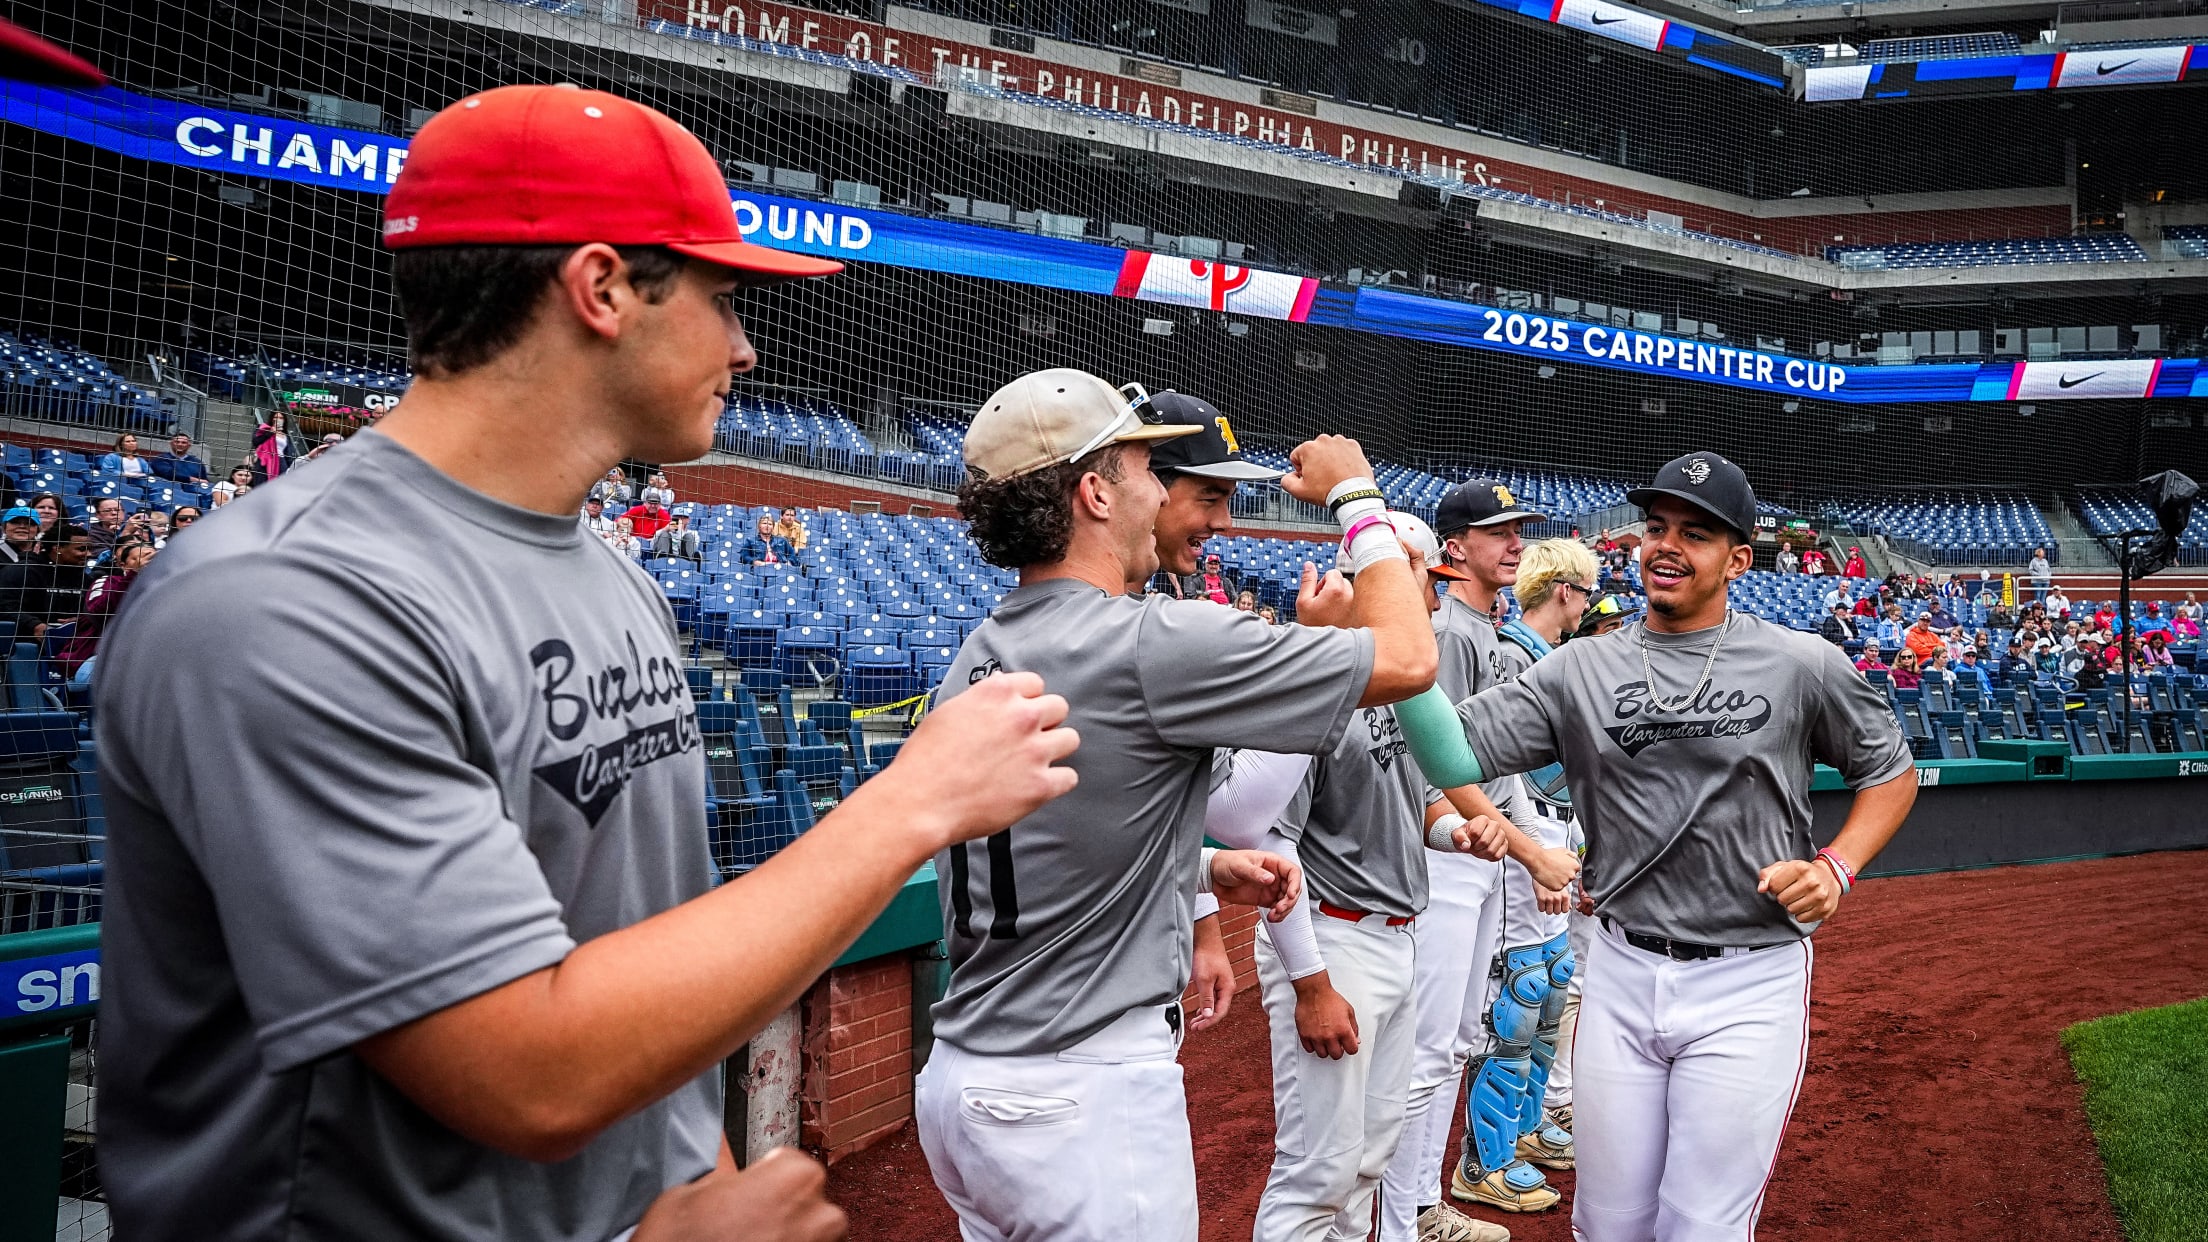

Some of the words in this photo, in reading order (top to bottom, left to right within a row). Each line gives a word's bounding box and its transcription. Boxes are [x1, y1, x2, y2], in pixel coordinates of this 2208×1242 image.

[687, 0, 819, 50] HOME
[849, 32, 900, 66] OF
[931, 47, 1007, 88] THE
[1341, 134, 1488, 186] PHILLIES
[1483, 310, 1570, 352] 2025
[1583, 327, 1774, 384] CARPENTER
[1785, 360, 1846, 393] CUP
[1613, 678, 1747, 720] Burlco
[1619, 721, 1706, 747] Carpenter
[1711, 714, 1751, 739] Cup
